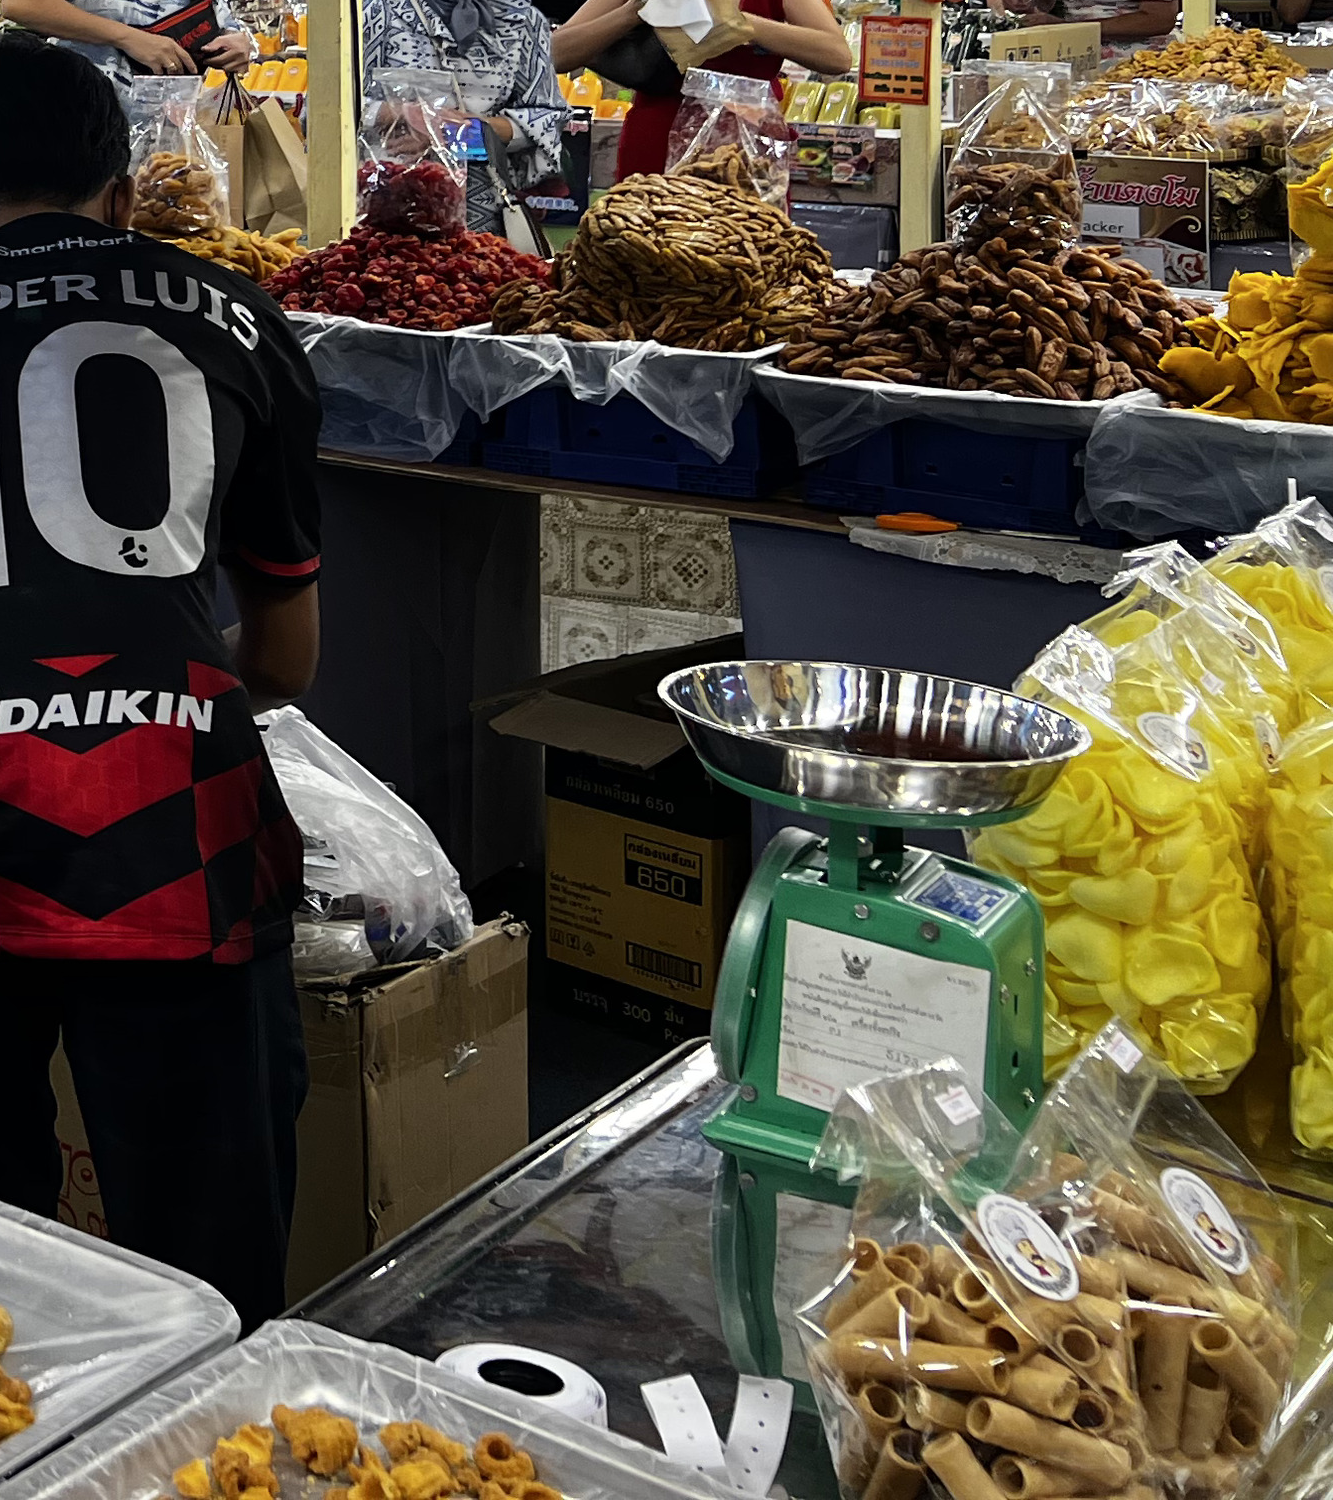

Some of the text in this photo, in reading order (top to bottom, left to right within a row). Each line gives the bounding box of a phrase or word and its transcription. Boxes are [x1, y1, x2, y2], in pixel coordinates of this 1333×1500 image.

[120, 270, 260, 352] LUIS
[645, 796, 675, 814] 650
[637, 865, 686, 898] 650
[622, 1002, 651, 1023] 300
